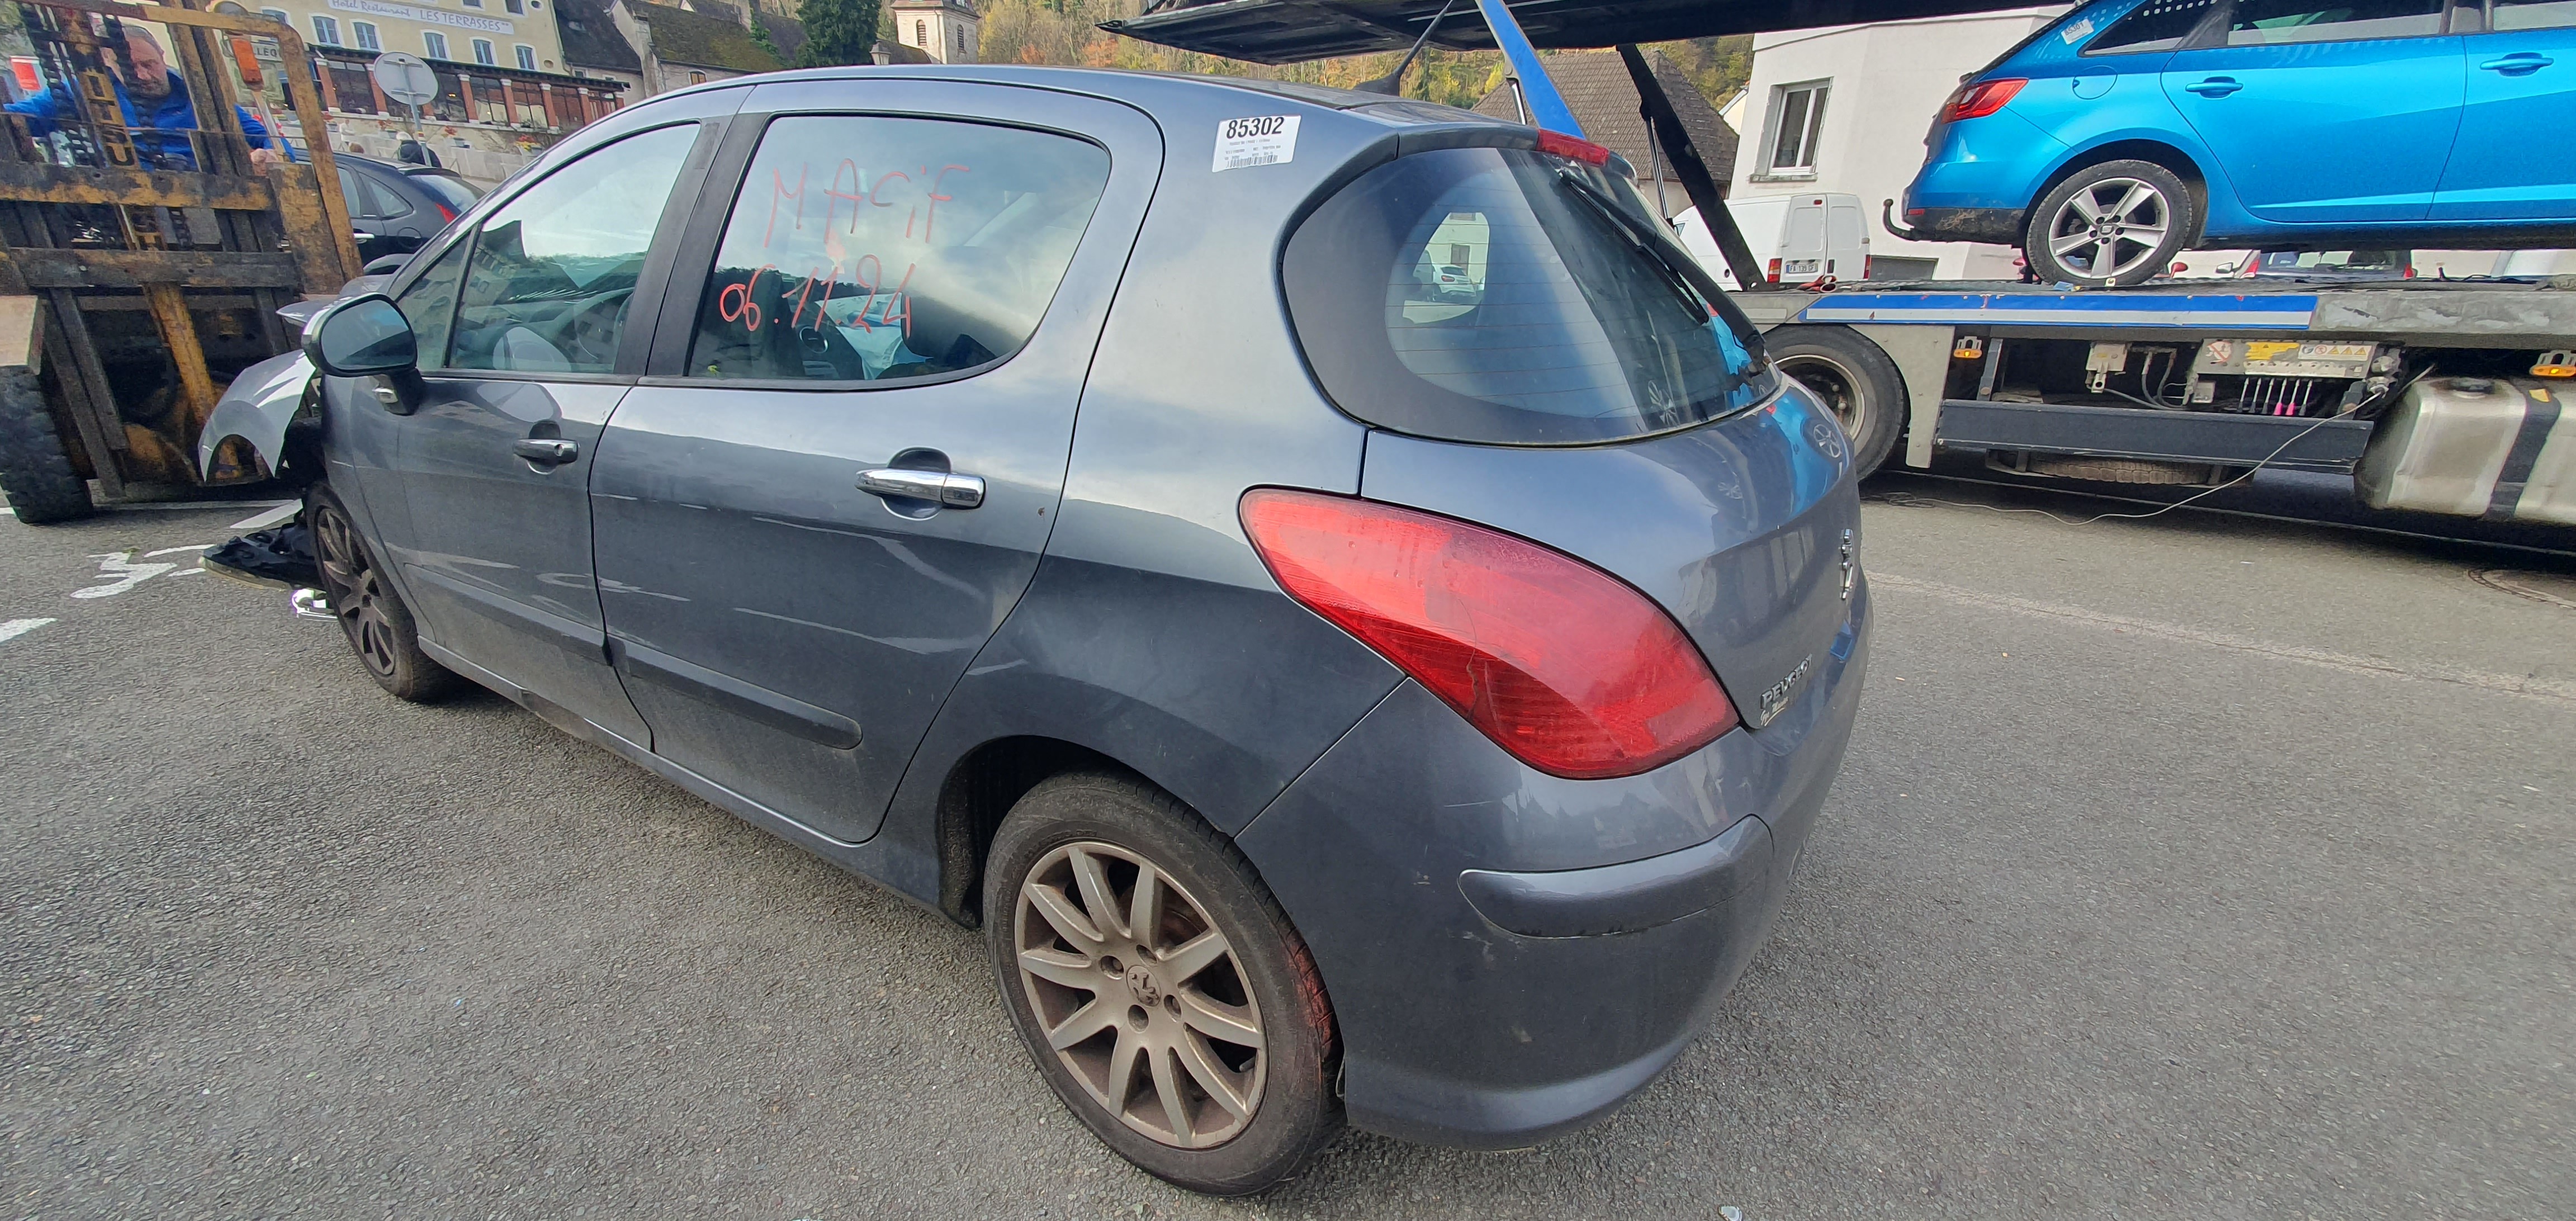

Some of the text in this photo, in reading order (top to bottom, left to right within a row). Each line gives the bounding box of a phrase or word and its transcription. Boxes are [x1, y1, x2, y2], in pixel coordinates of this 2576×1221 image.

[361, 1, 410, 17] Restaurant
[420, 10, 439, 22] LES
[442, 13, 501, 31] TERRASSES
[2064, 22, 2085, 36] 85301
[1226, 116, 1285, 139] 85302
[1760, 653, 1812, 709] PEUGEOT
